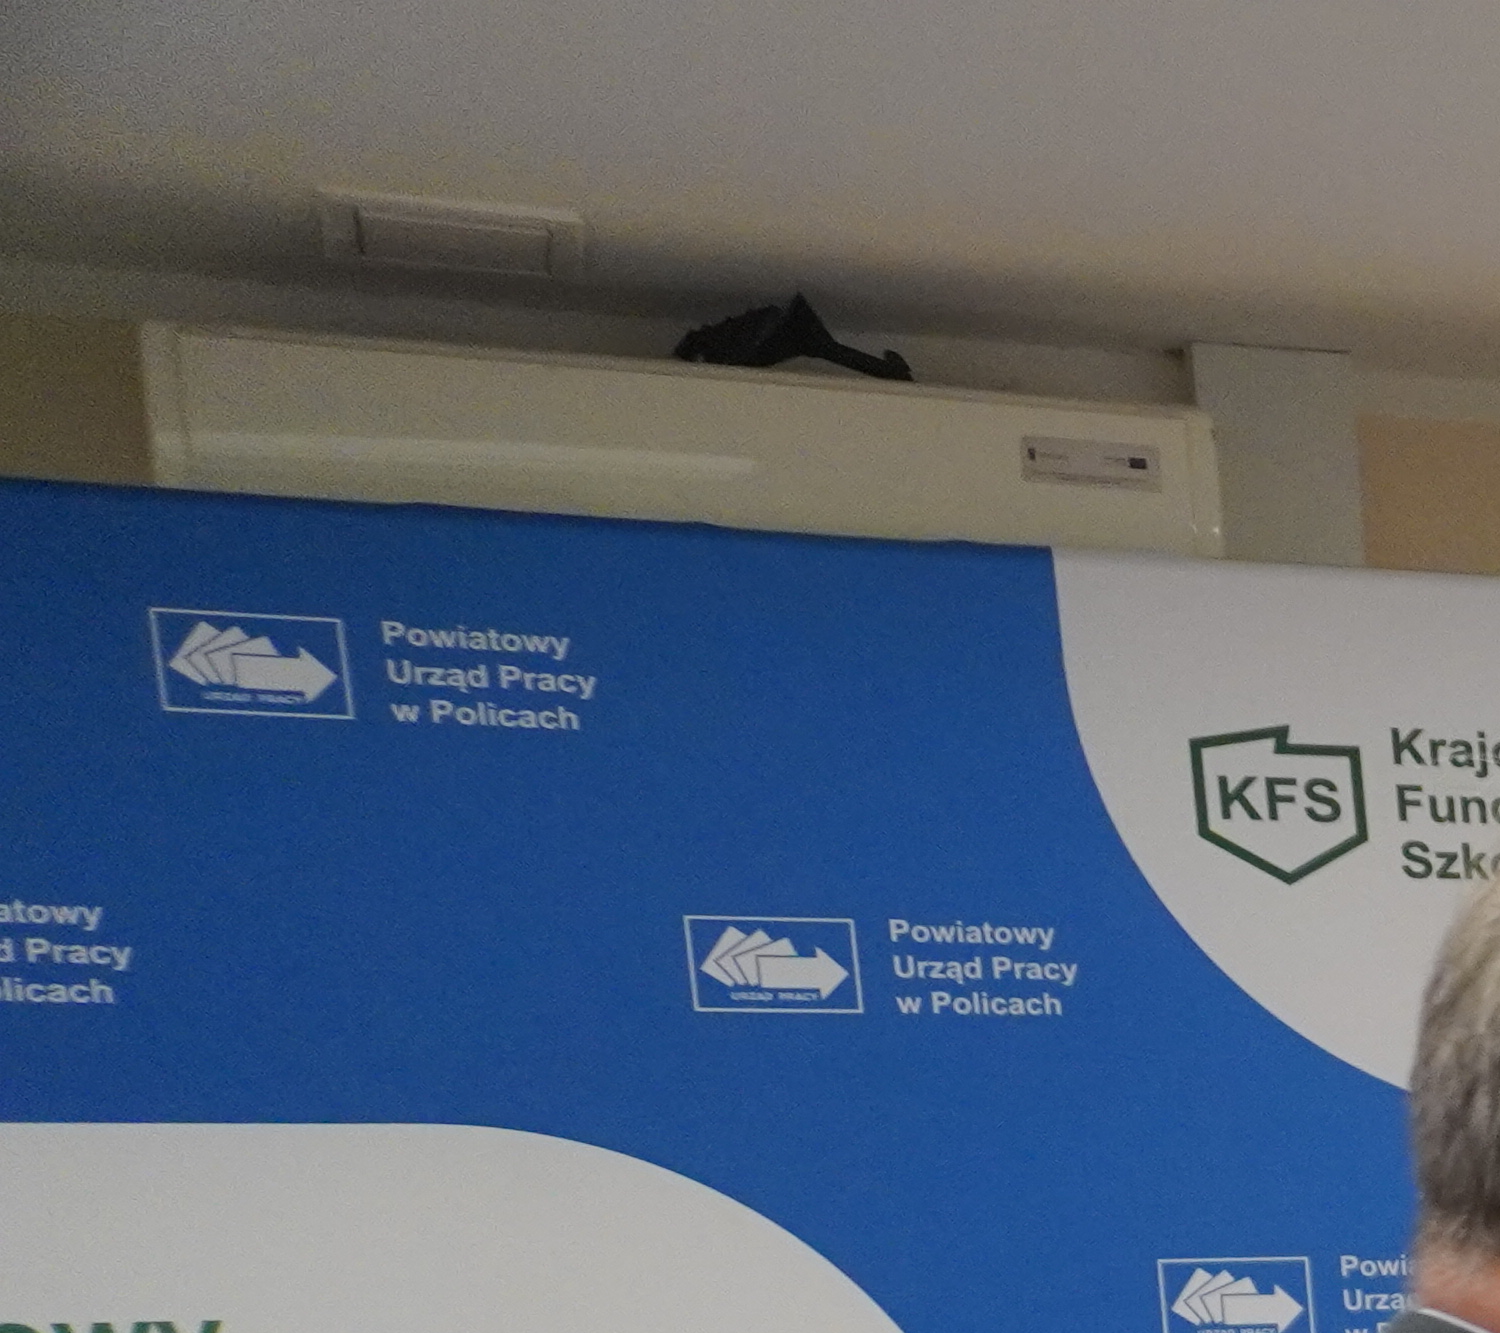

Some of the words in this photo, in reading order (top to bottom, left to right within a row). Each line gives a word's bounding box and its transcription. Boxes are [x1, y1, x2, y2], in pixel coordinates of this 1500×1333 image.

[380, 620, 571, 660] Powiatowy
[386, 659, 489, 694] Urząd
[499, 664, 597, 699] Pracy
[391, 702, 419, 724] w
[431, 700, 581, 731] Policach
[1217, 775, 1341, 822] KFS
[0, 899, 103, 931] atowy
[889, 918, 1054, 949] Powiatowy
[25, 937, 133, 971] Pracy
[893, 956, 982, 984] Urząd
[992, 957, 1078, 986] Pracy
[0, 976, 115, 1004] licach
[896, 996, 920, 1014] w
[932, 991, 1063, 1016] Policach
